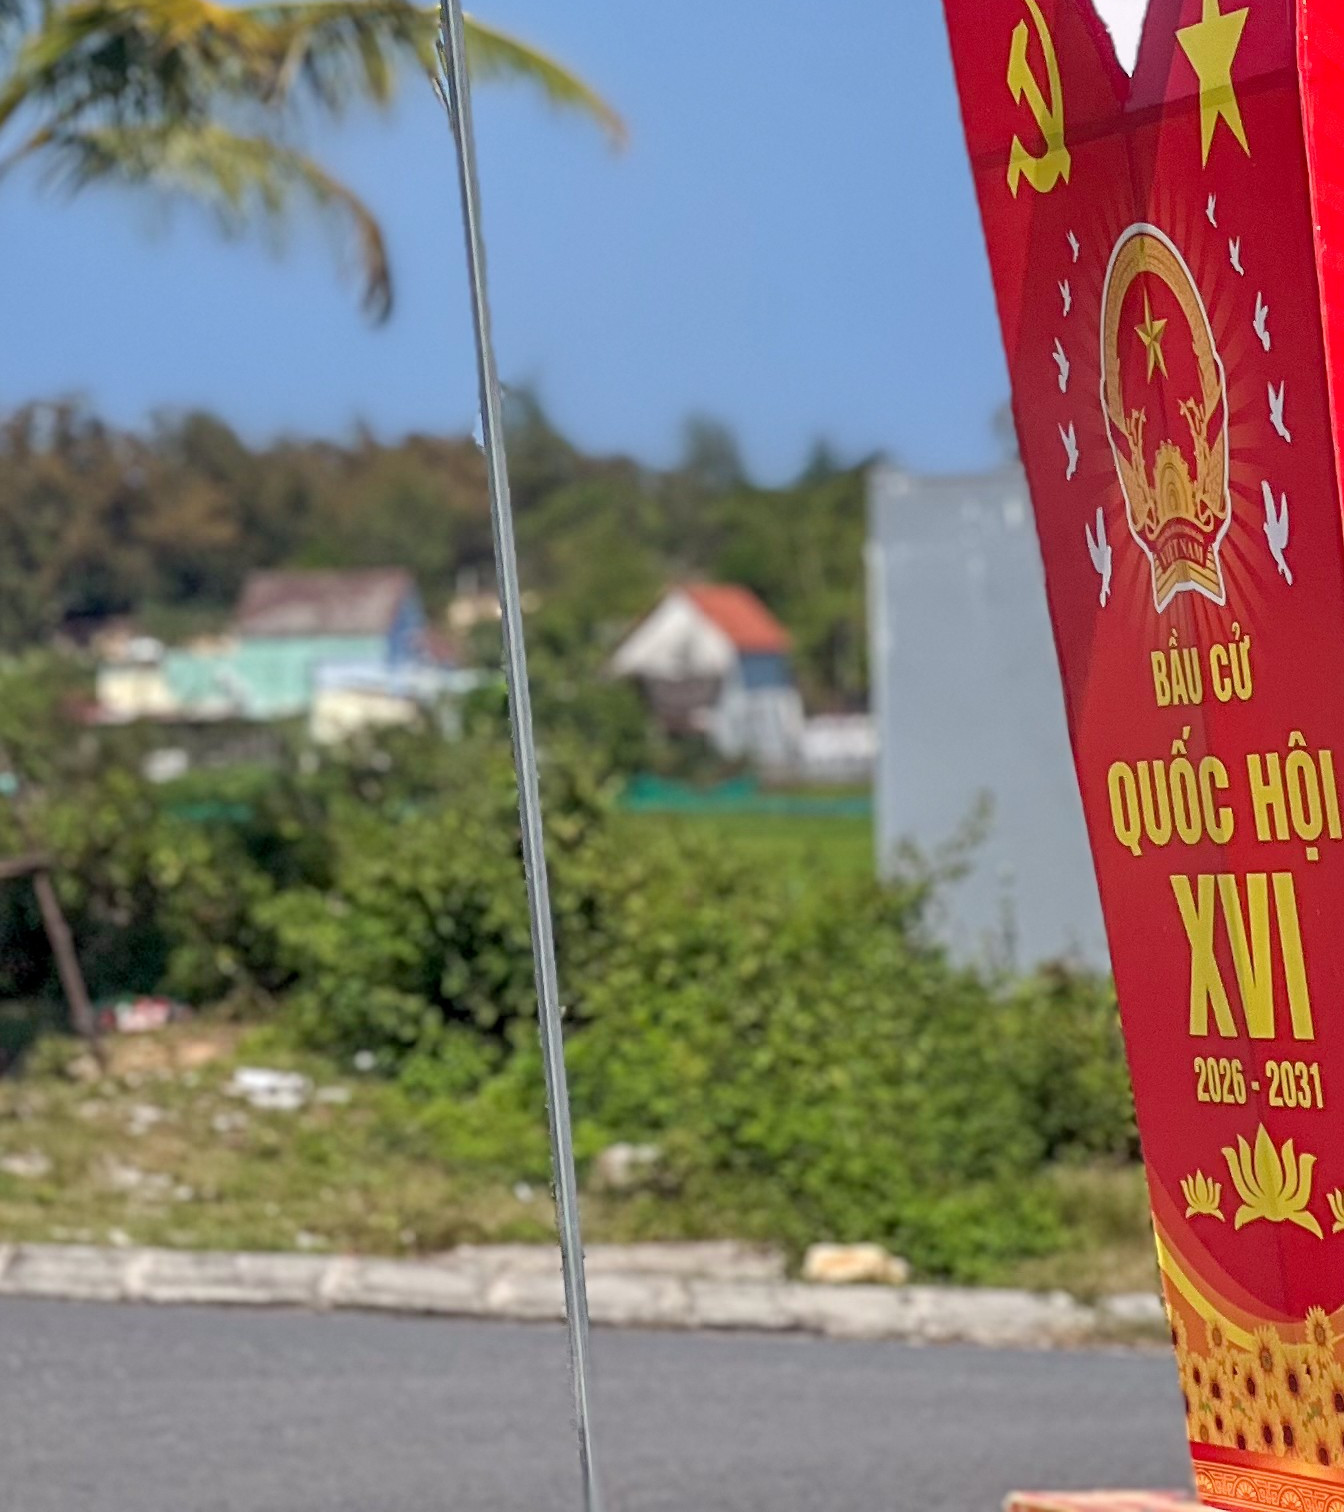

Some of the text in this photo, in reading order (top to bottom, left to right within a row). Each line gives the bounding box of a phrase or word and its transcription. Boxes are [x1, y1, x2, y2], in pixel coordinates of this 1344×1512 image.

[1150, 623, 1254, 707] BẦU CỬ
[1107, 727, 1344, 861] QUỐC HỘI
[1169, 872, 1315, 1041] XVI
[1193, 1056, 1247, 1105] 2026
[1264, 1060, 1324, 1109] 2031
